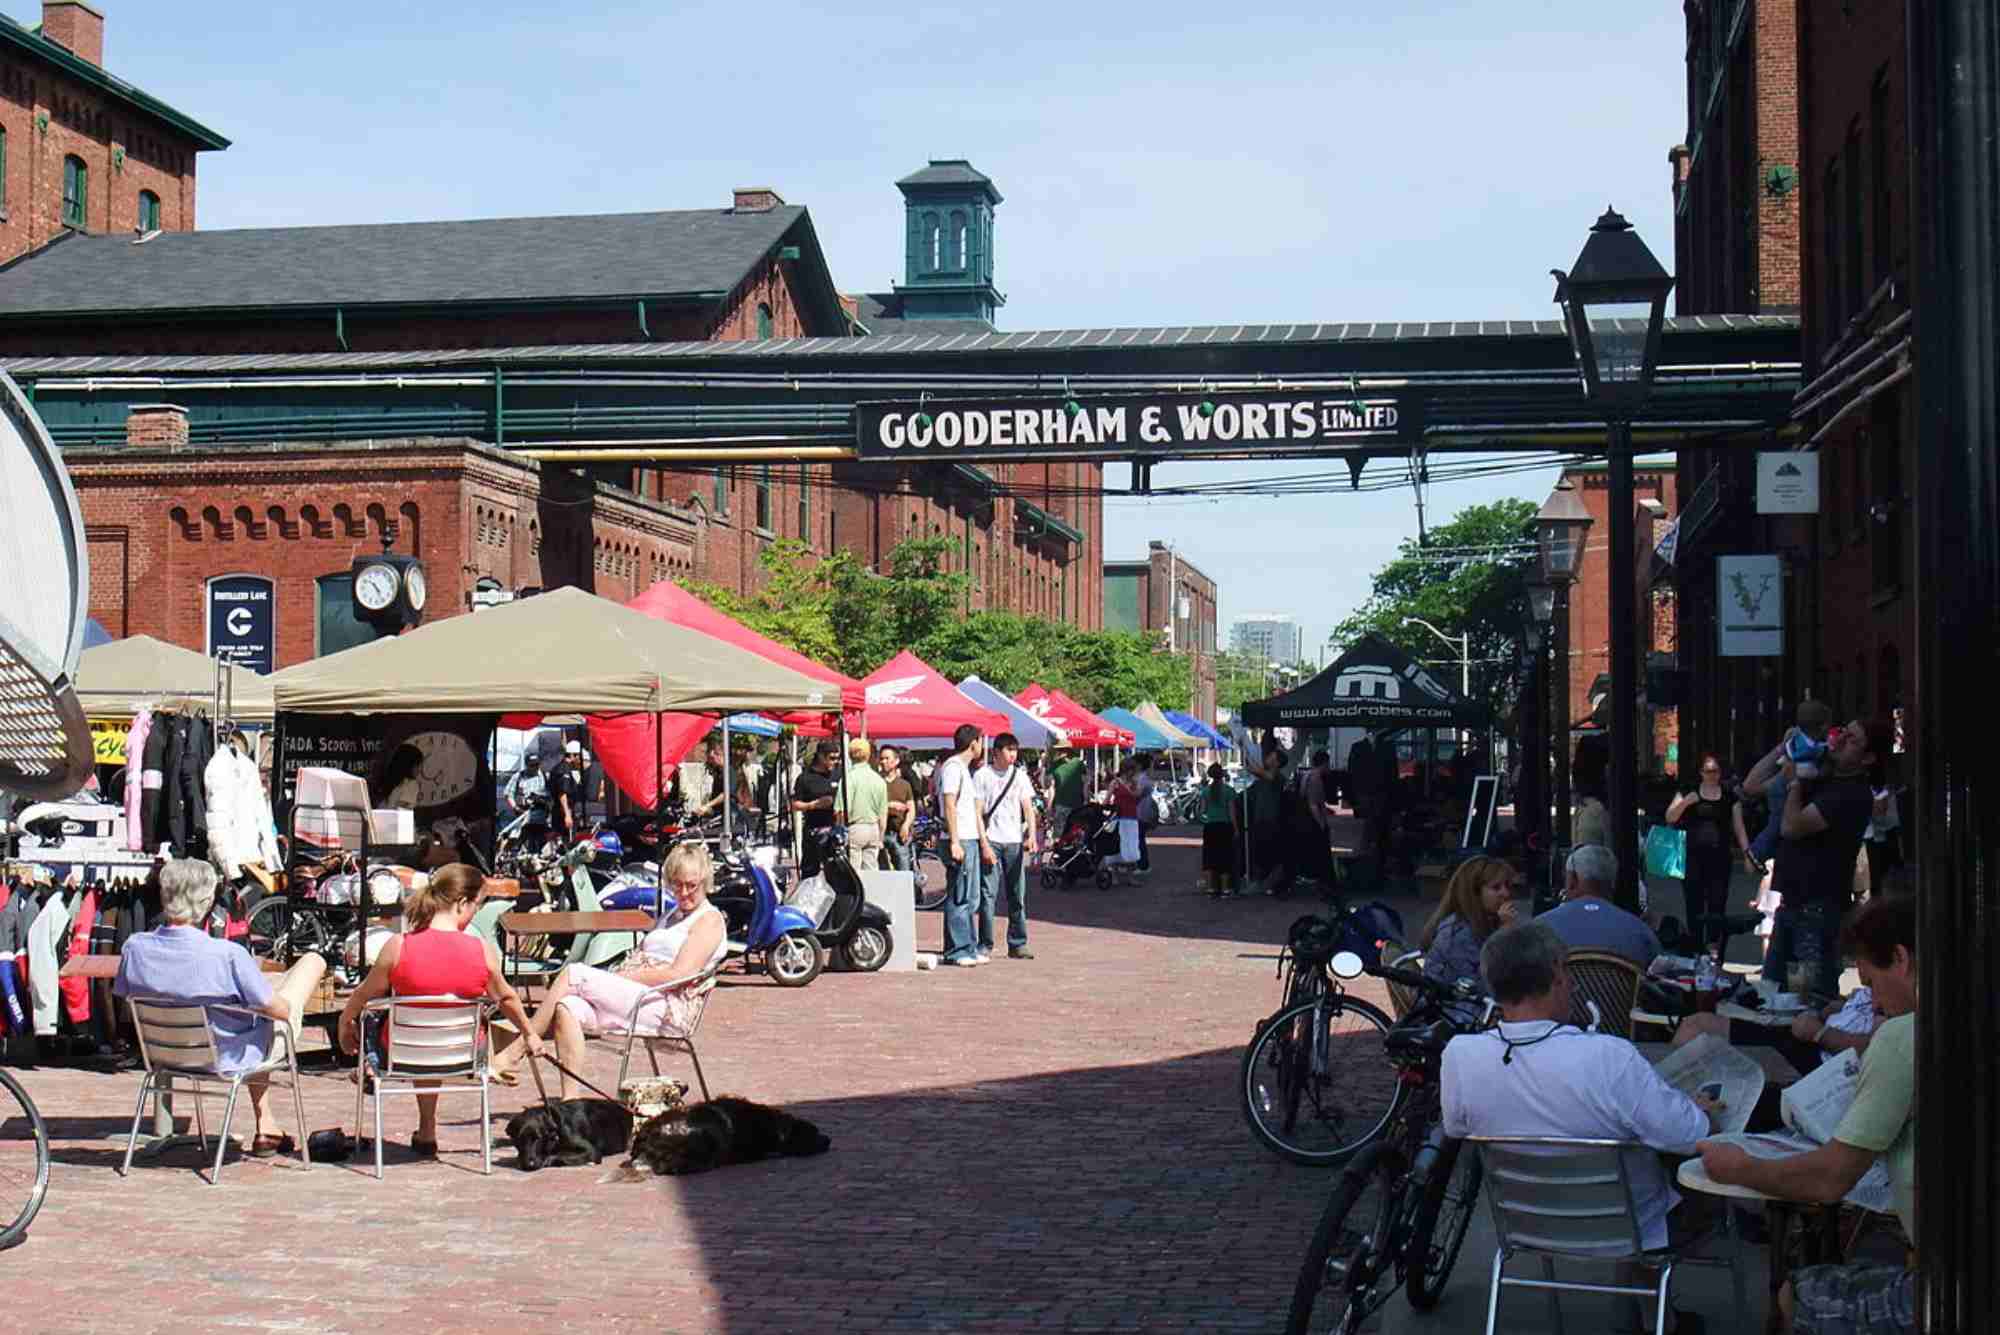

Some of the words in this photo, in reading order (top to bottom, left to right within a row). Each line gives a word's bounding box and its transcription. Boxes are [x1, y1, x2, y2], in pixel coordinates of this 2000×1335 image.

[879, 407, 1127, 448] GOODERHAM
[1139, 406, 1171, 443] &
[1177, 401, 1316, 441] WORTS
[1322, 406, 1398, 430] LIMITED
[1280, 703, 1452, 719] www.modrobes.com
